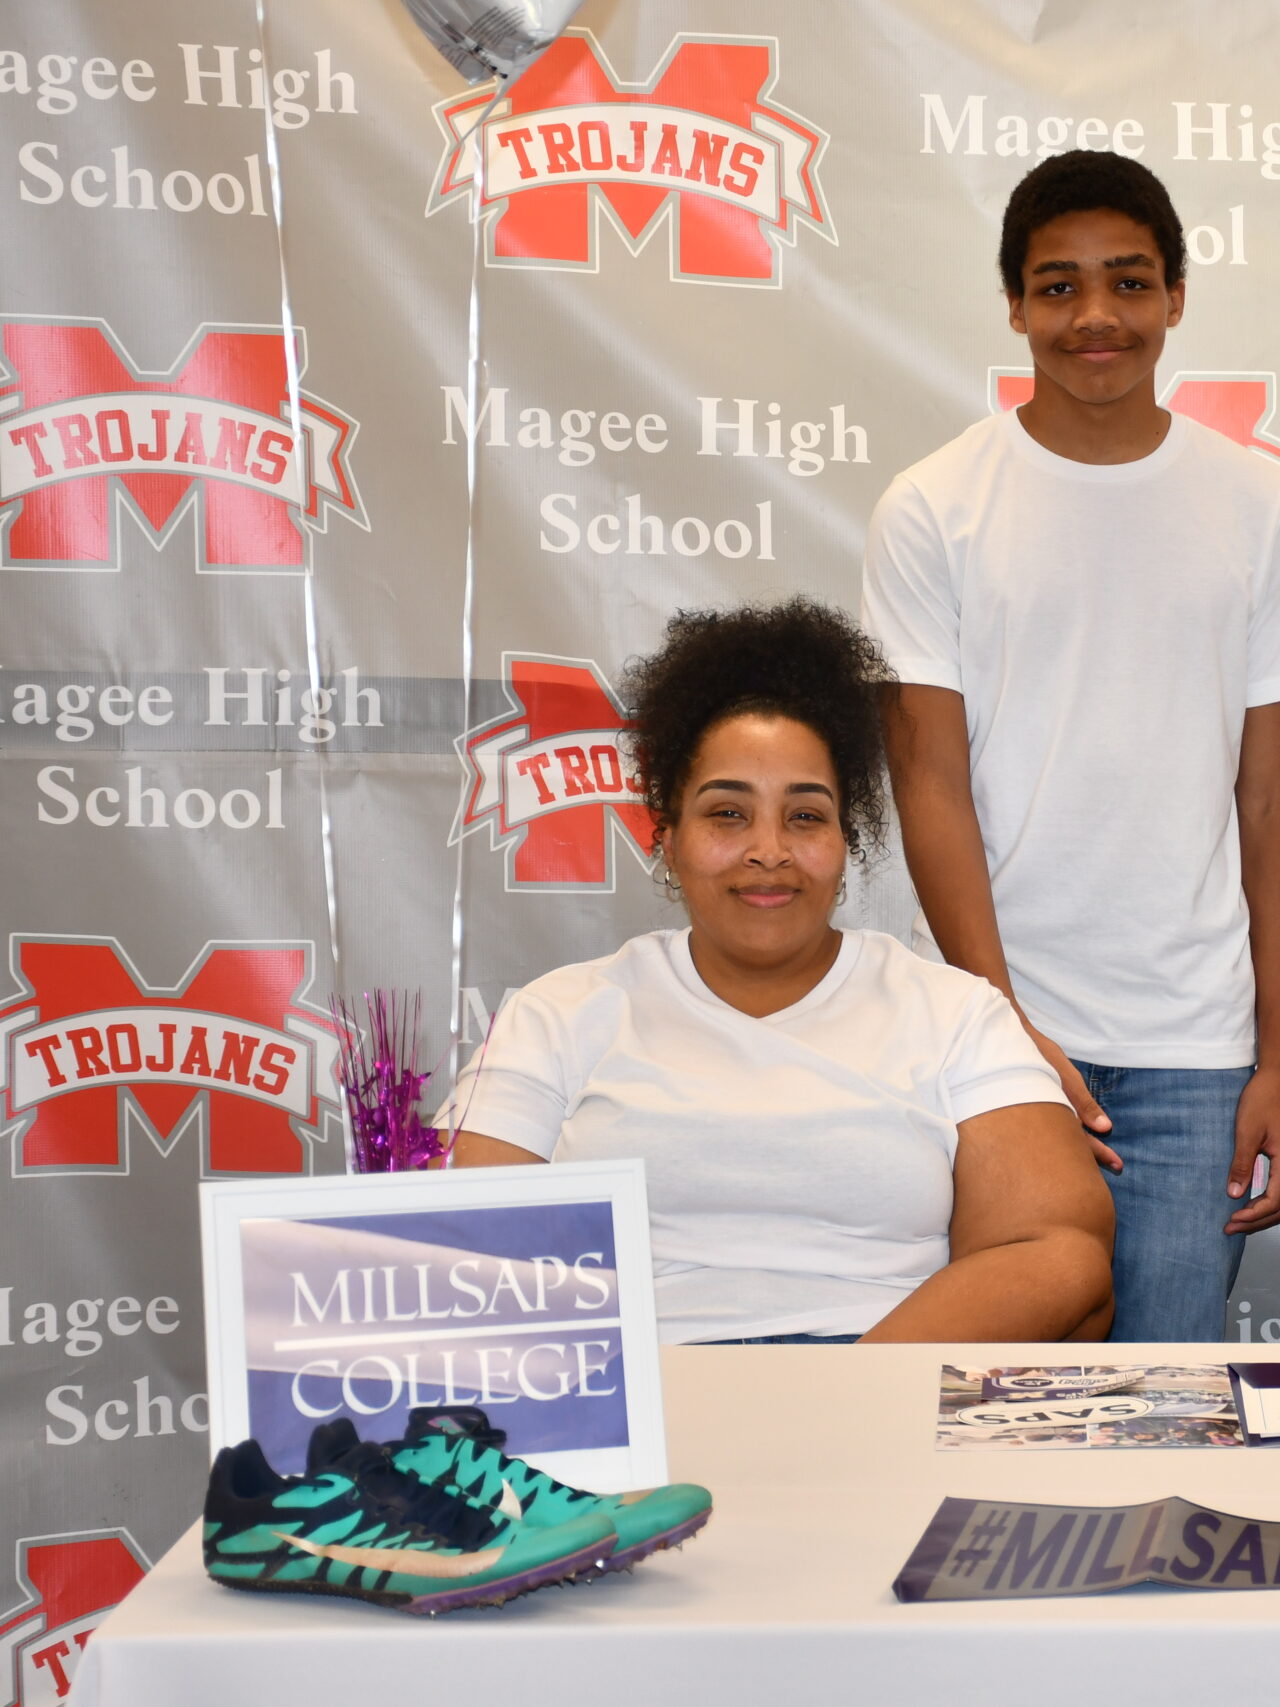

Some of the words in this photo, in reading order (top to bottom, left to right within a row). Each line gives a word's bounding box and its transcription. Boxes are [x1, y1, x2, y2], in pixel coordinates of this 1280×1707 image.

[0, 50, 157, 115] agee
[177, 43, 359, 129] High
[496, 120, 766, 198] TROJANS
[919, 93, 1146, 166] Magee
[18, 141, 268, 217] School
[8, 409, 294, 485] TROJANS
[440, 385, 668, 467] Magee
[696, 396, 872, 478] High
[539, 493, 776, 561] School
[0, 666, 174, 742] agee
[203, 666, 385, 744] High
[36, 765, 286, 829] School
[24, 1022, 297, 1096] TROJANS
[289, 1252, 610, 1328] MILLSAPS
[45, 1375, 210, 1446] Scho
[291, 1340, 617, 1419] COLLEGE
[974, 1403, 1137, 1426] SAPS
